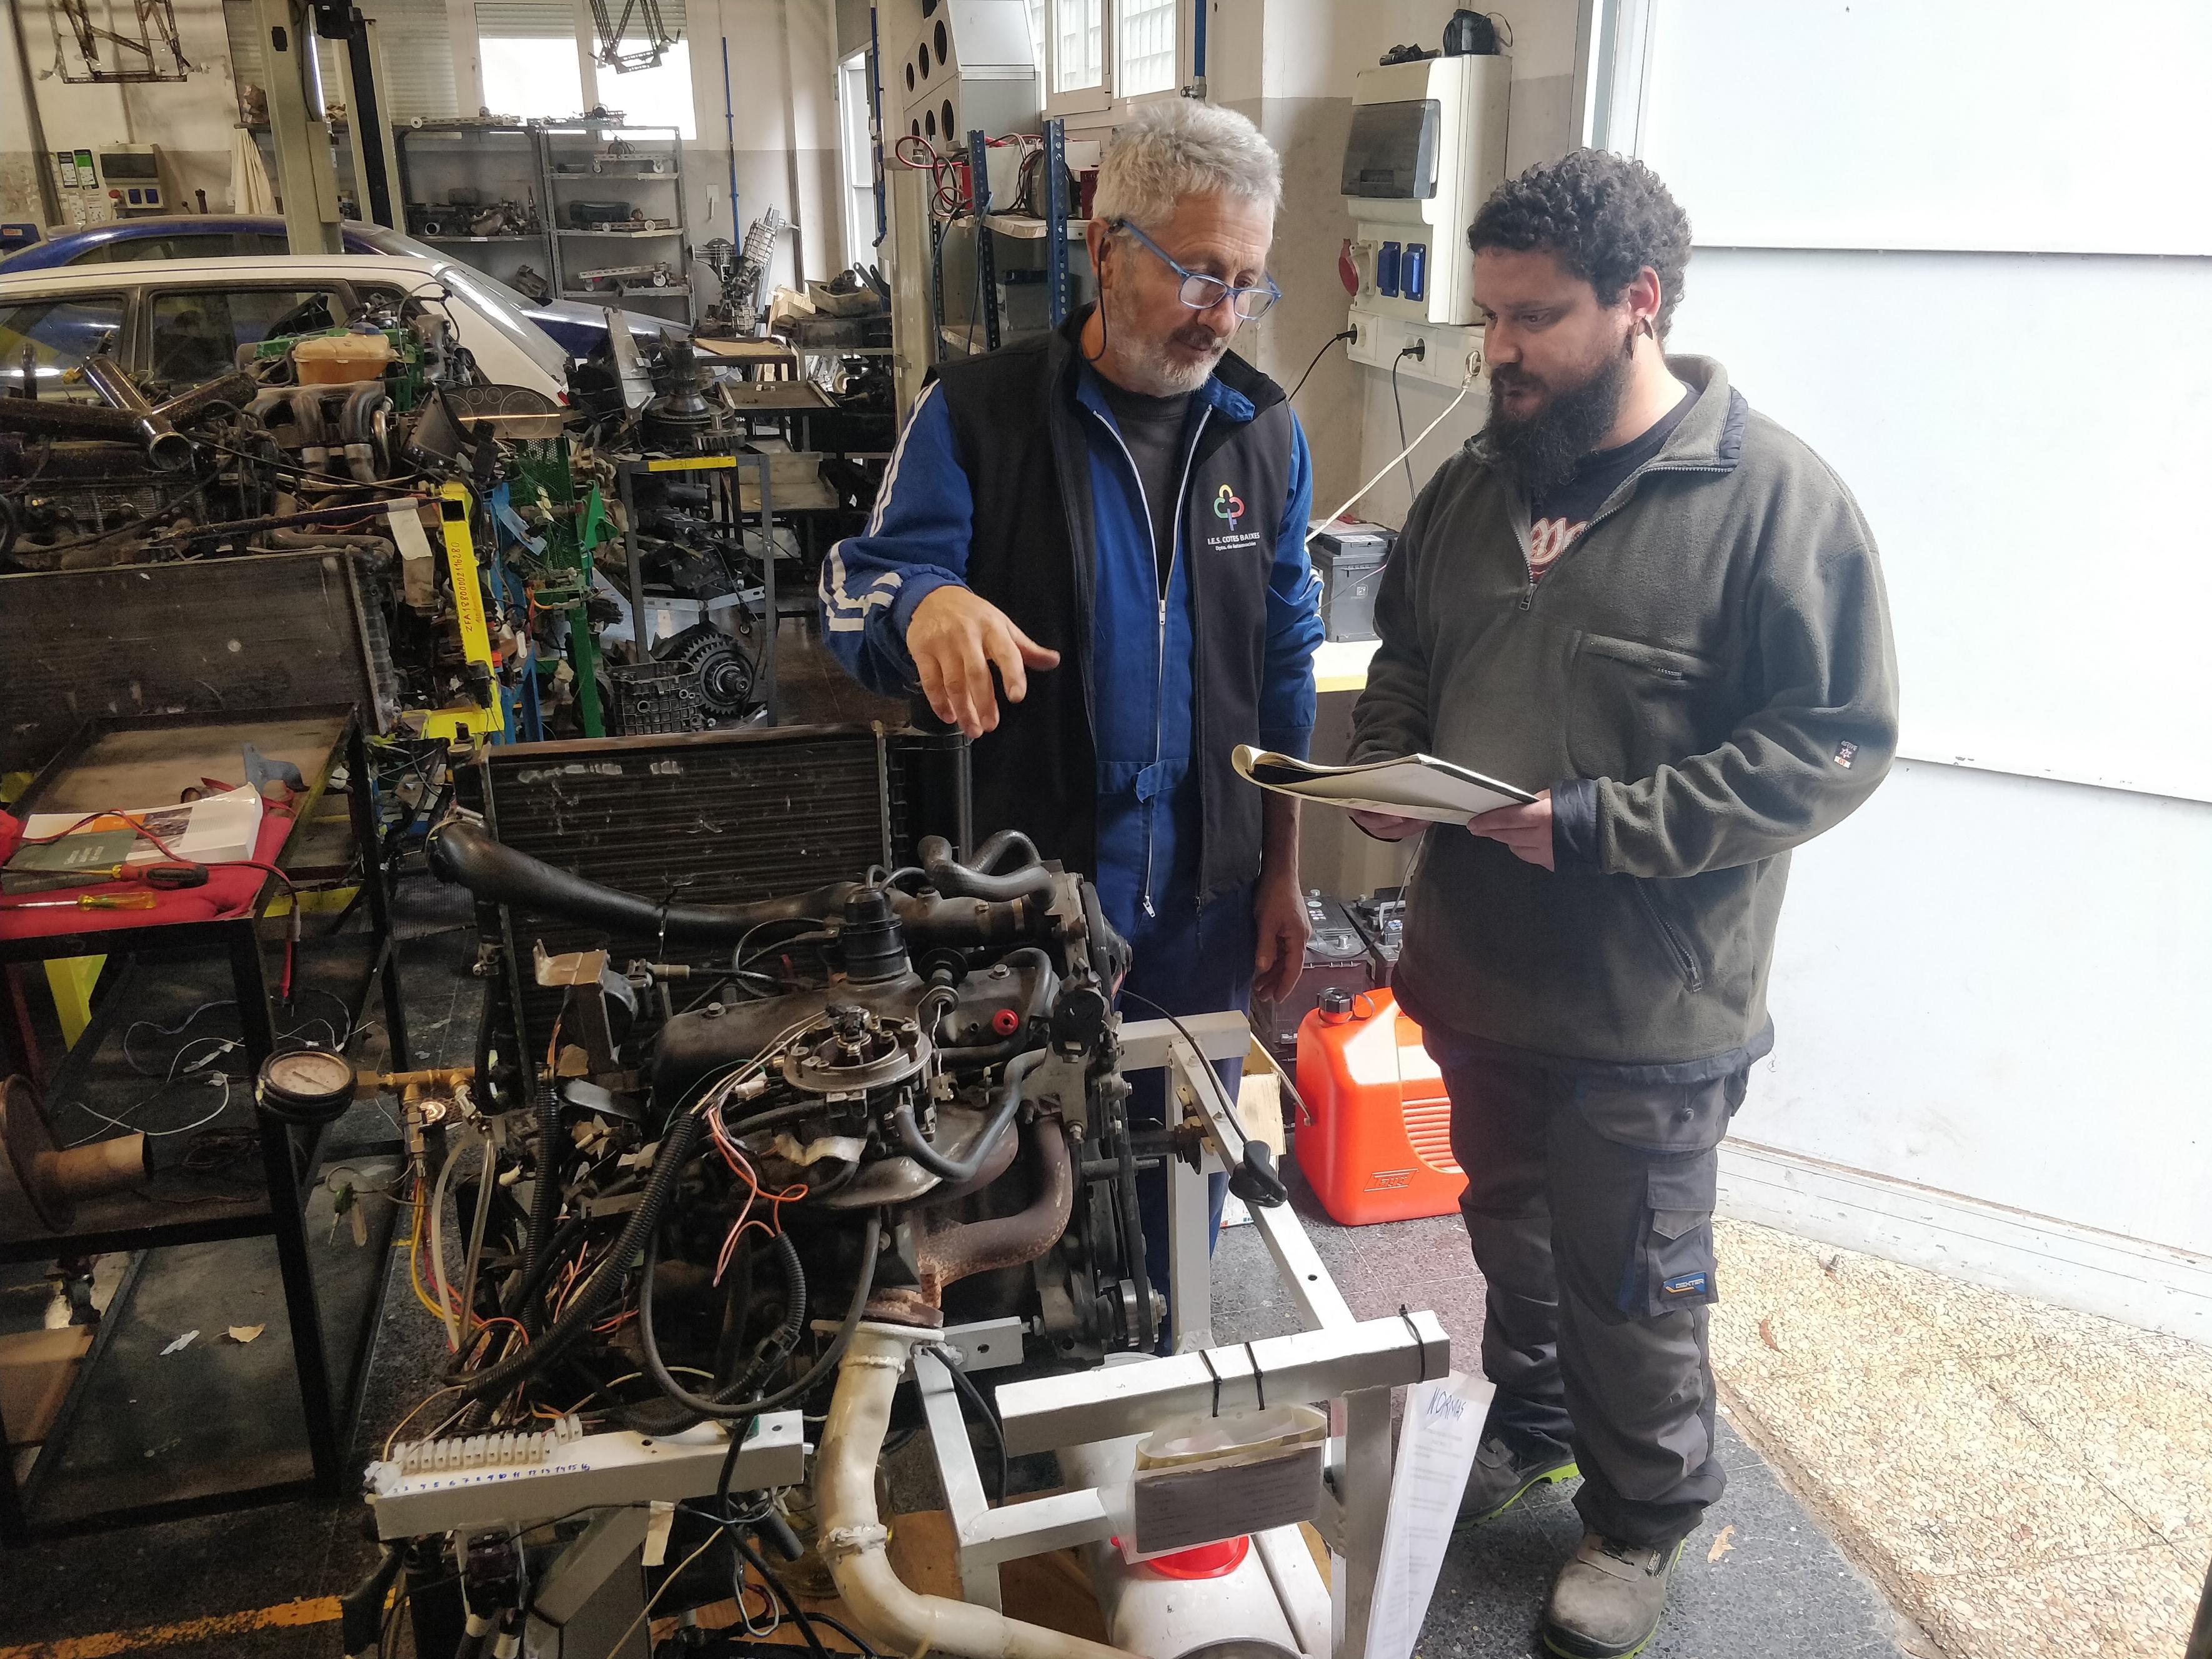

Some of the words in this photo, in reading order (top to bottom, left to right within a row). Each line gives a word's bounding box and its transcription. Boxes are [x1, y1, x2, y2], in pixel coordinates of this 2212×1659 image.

[1207, 537, 1222, 545] I.E.S.
[1222, 535, 1240, 543] COTES
[1240, 532, 1260, 541] BAIXES
[1675, 1278, 1705, 1288] DEXTER
[1427, 1386, 1467, 1422] NORMAS
